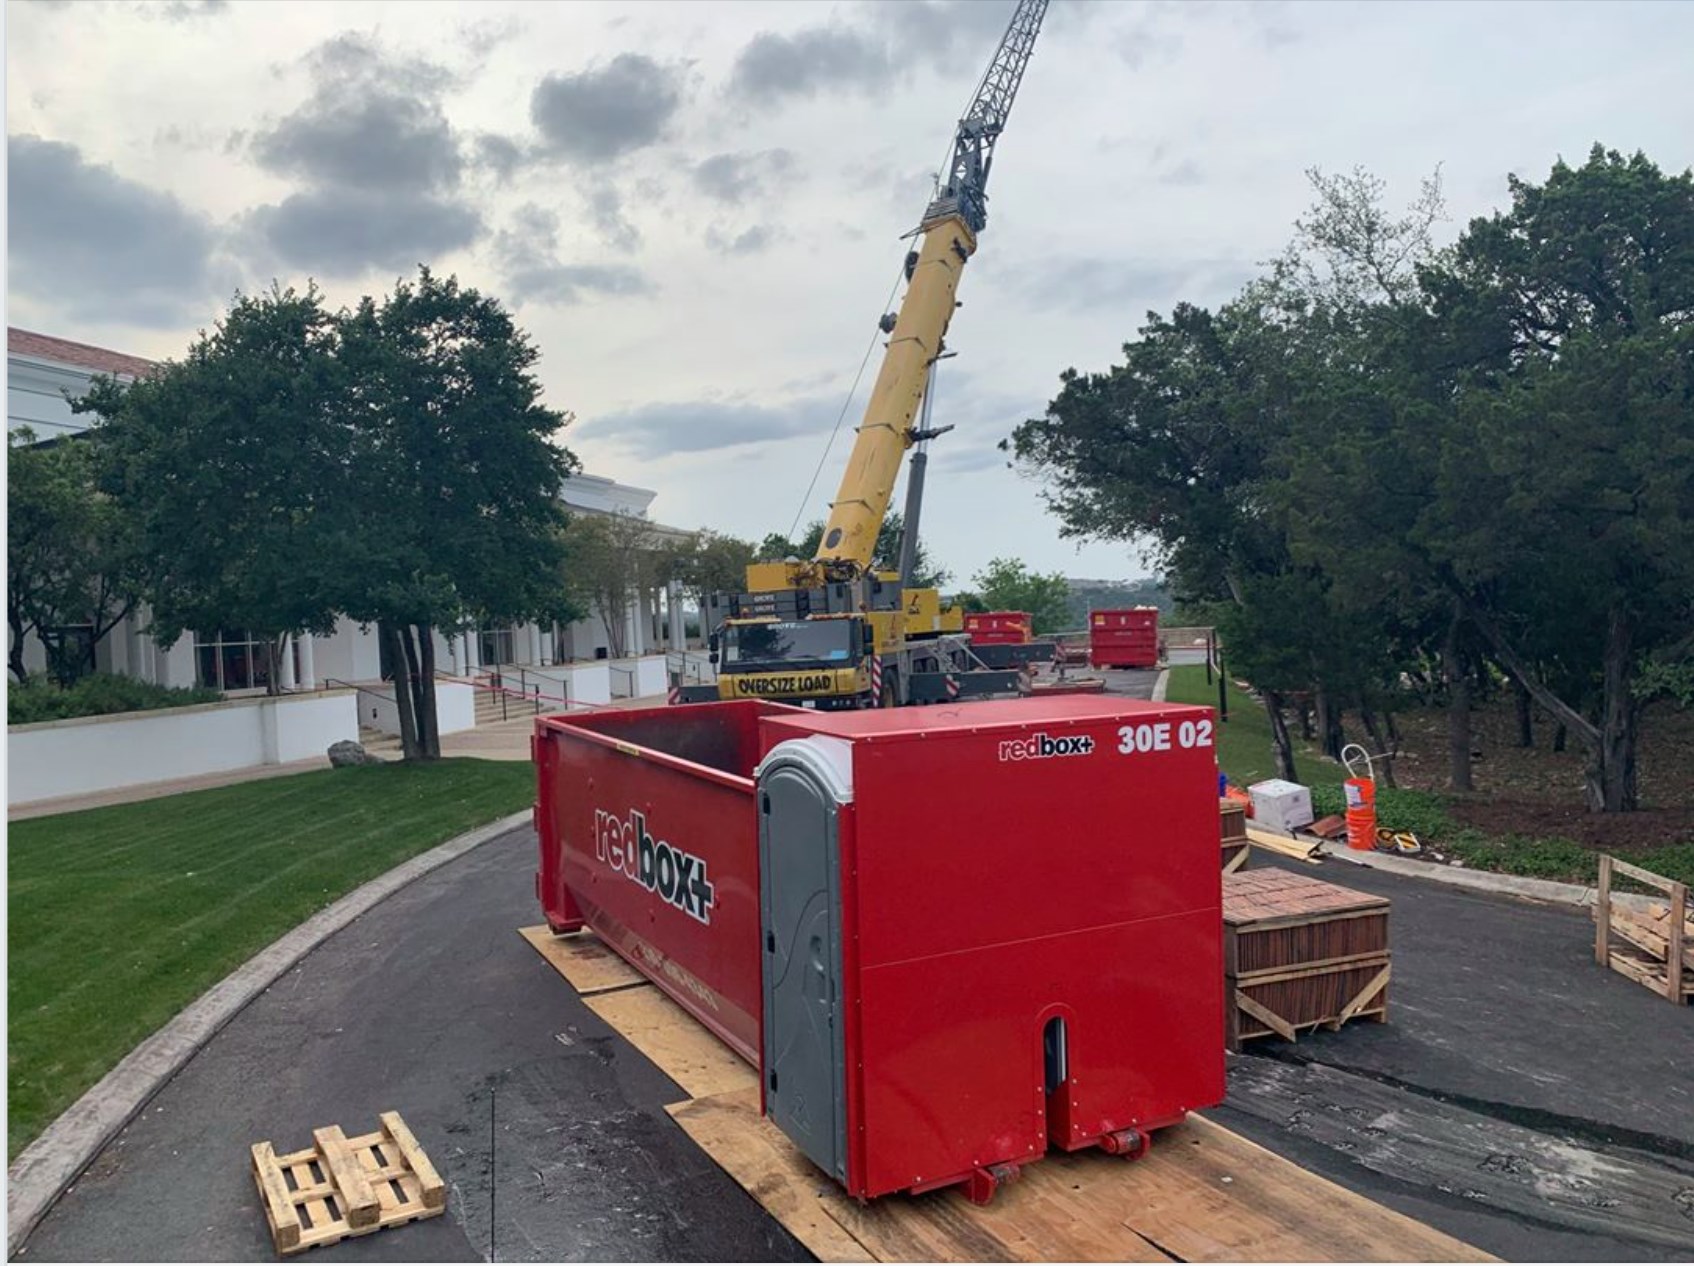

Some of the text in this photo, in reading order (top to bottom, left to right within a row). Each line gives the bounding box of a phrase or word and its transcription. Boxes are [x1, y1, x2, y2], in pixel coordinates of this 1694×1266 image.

[738, 674, 832, 693] OVERSIZE LOAD
[999, 732, 1095, 761] redbox+
[1118, 719, 1213, 755] 30E 02
[595, 808, 714, 926] redbox+
